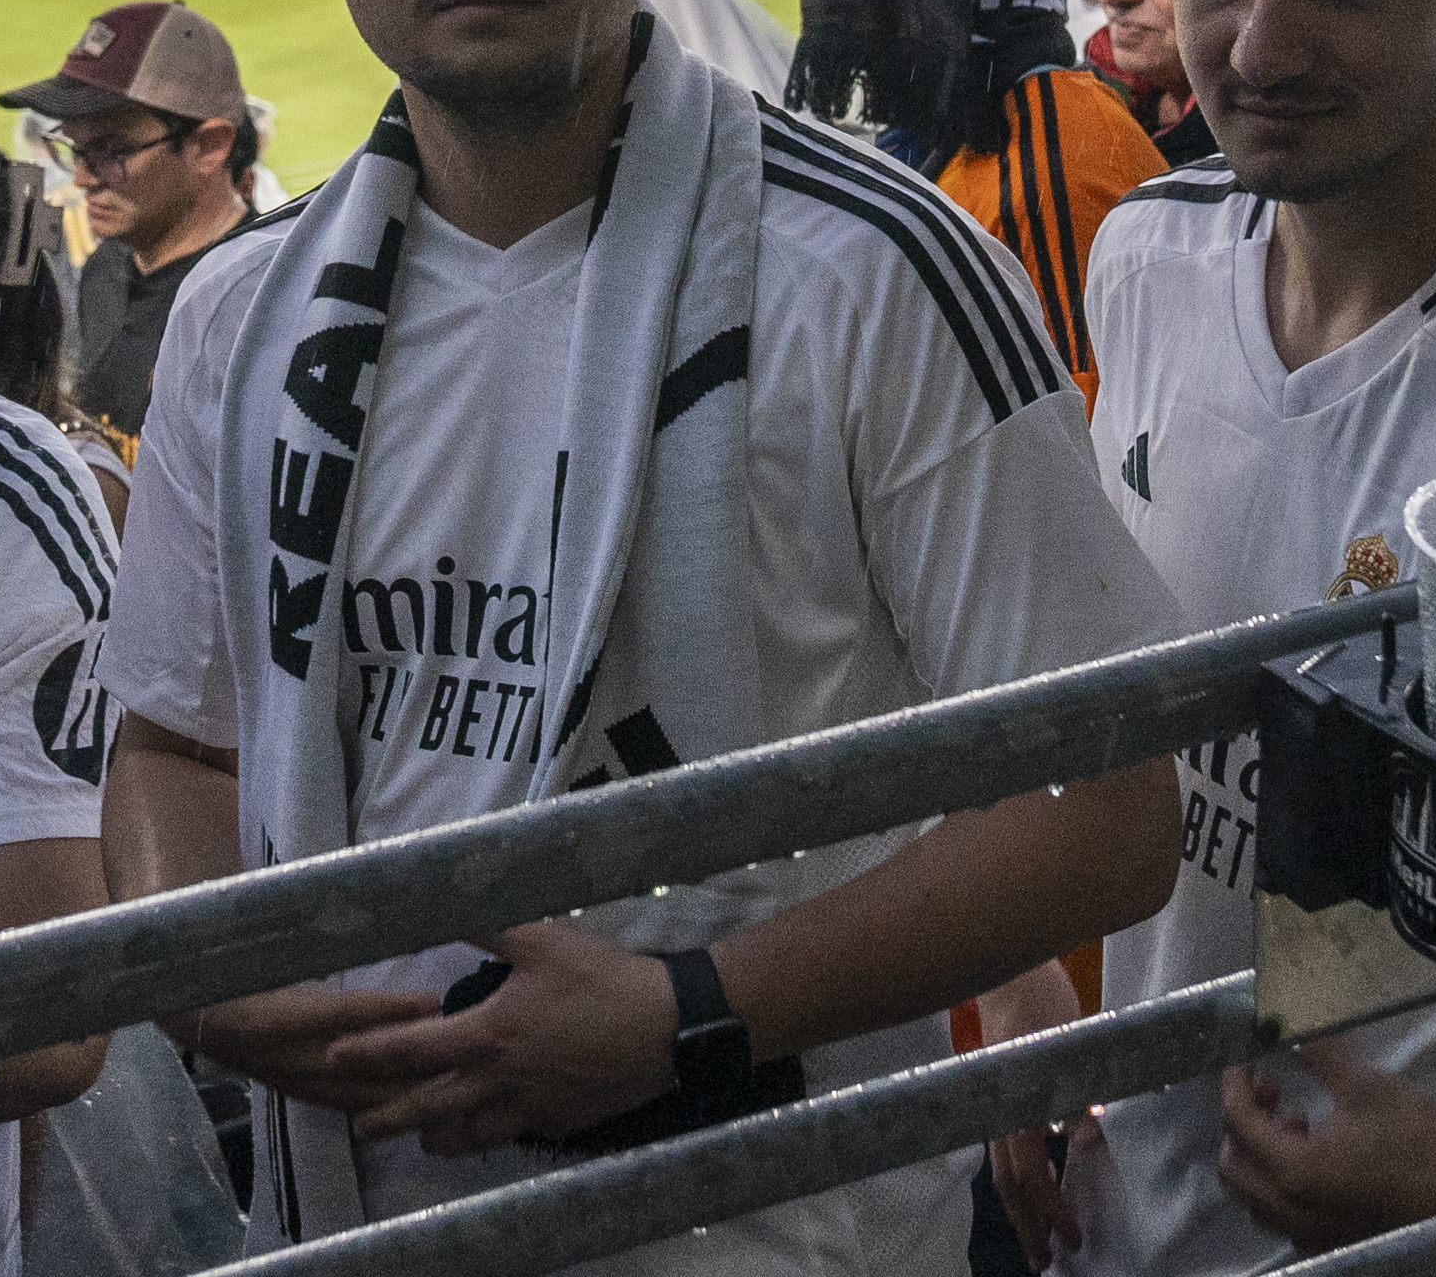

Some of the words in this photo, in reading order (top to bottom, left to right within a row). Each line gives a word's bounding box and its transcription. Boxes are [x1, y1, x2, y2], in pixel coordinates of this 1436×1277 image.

[269, 215, 406, 682] REAL
[342, 555, 538, 667] mira
[418, 674, 538, 764] BETT
[1181, 788, 1255, 890] BET
